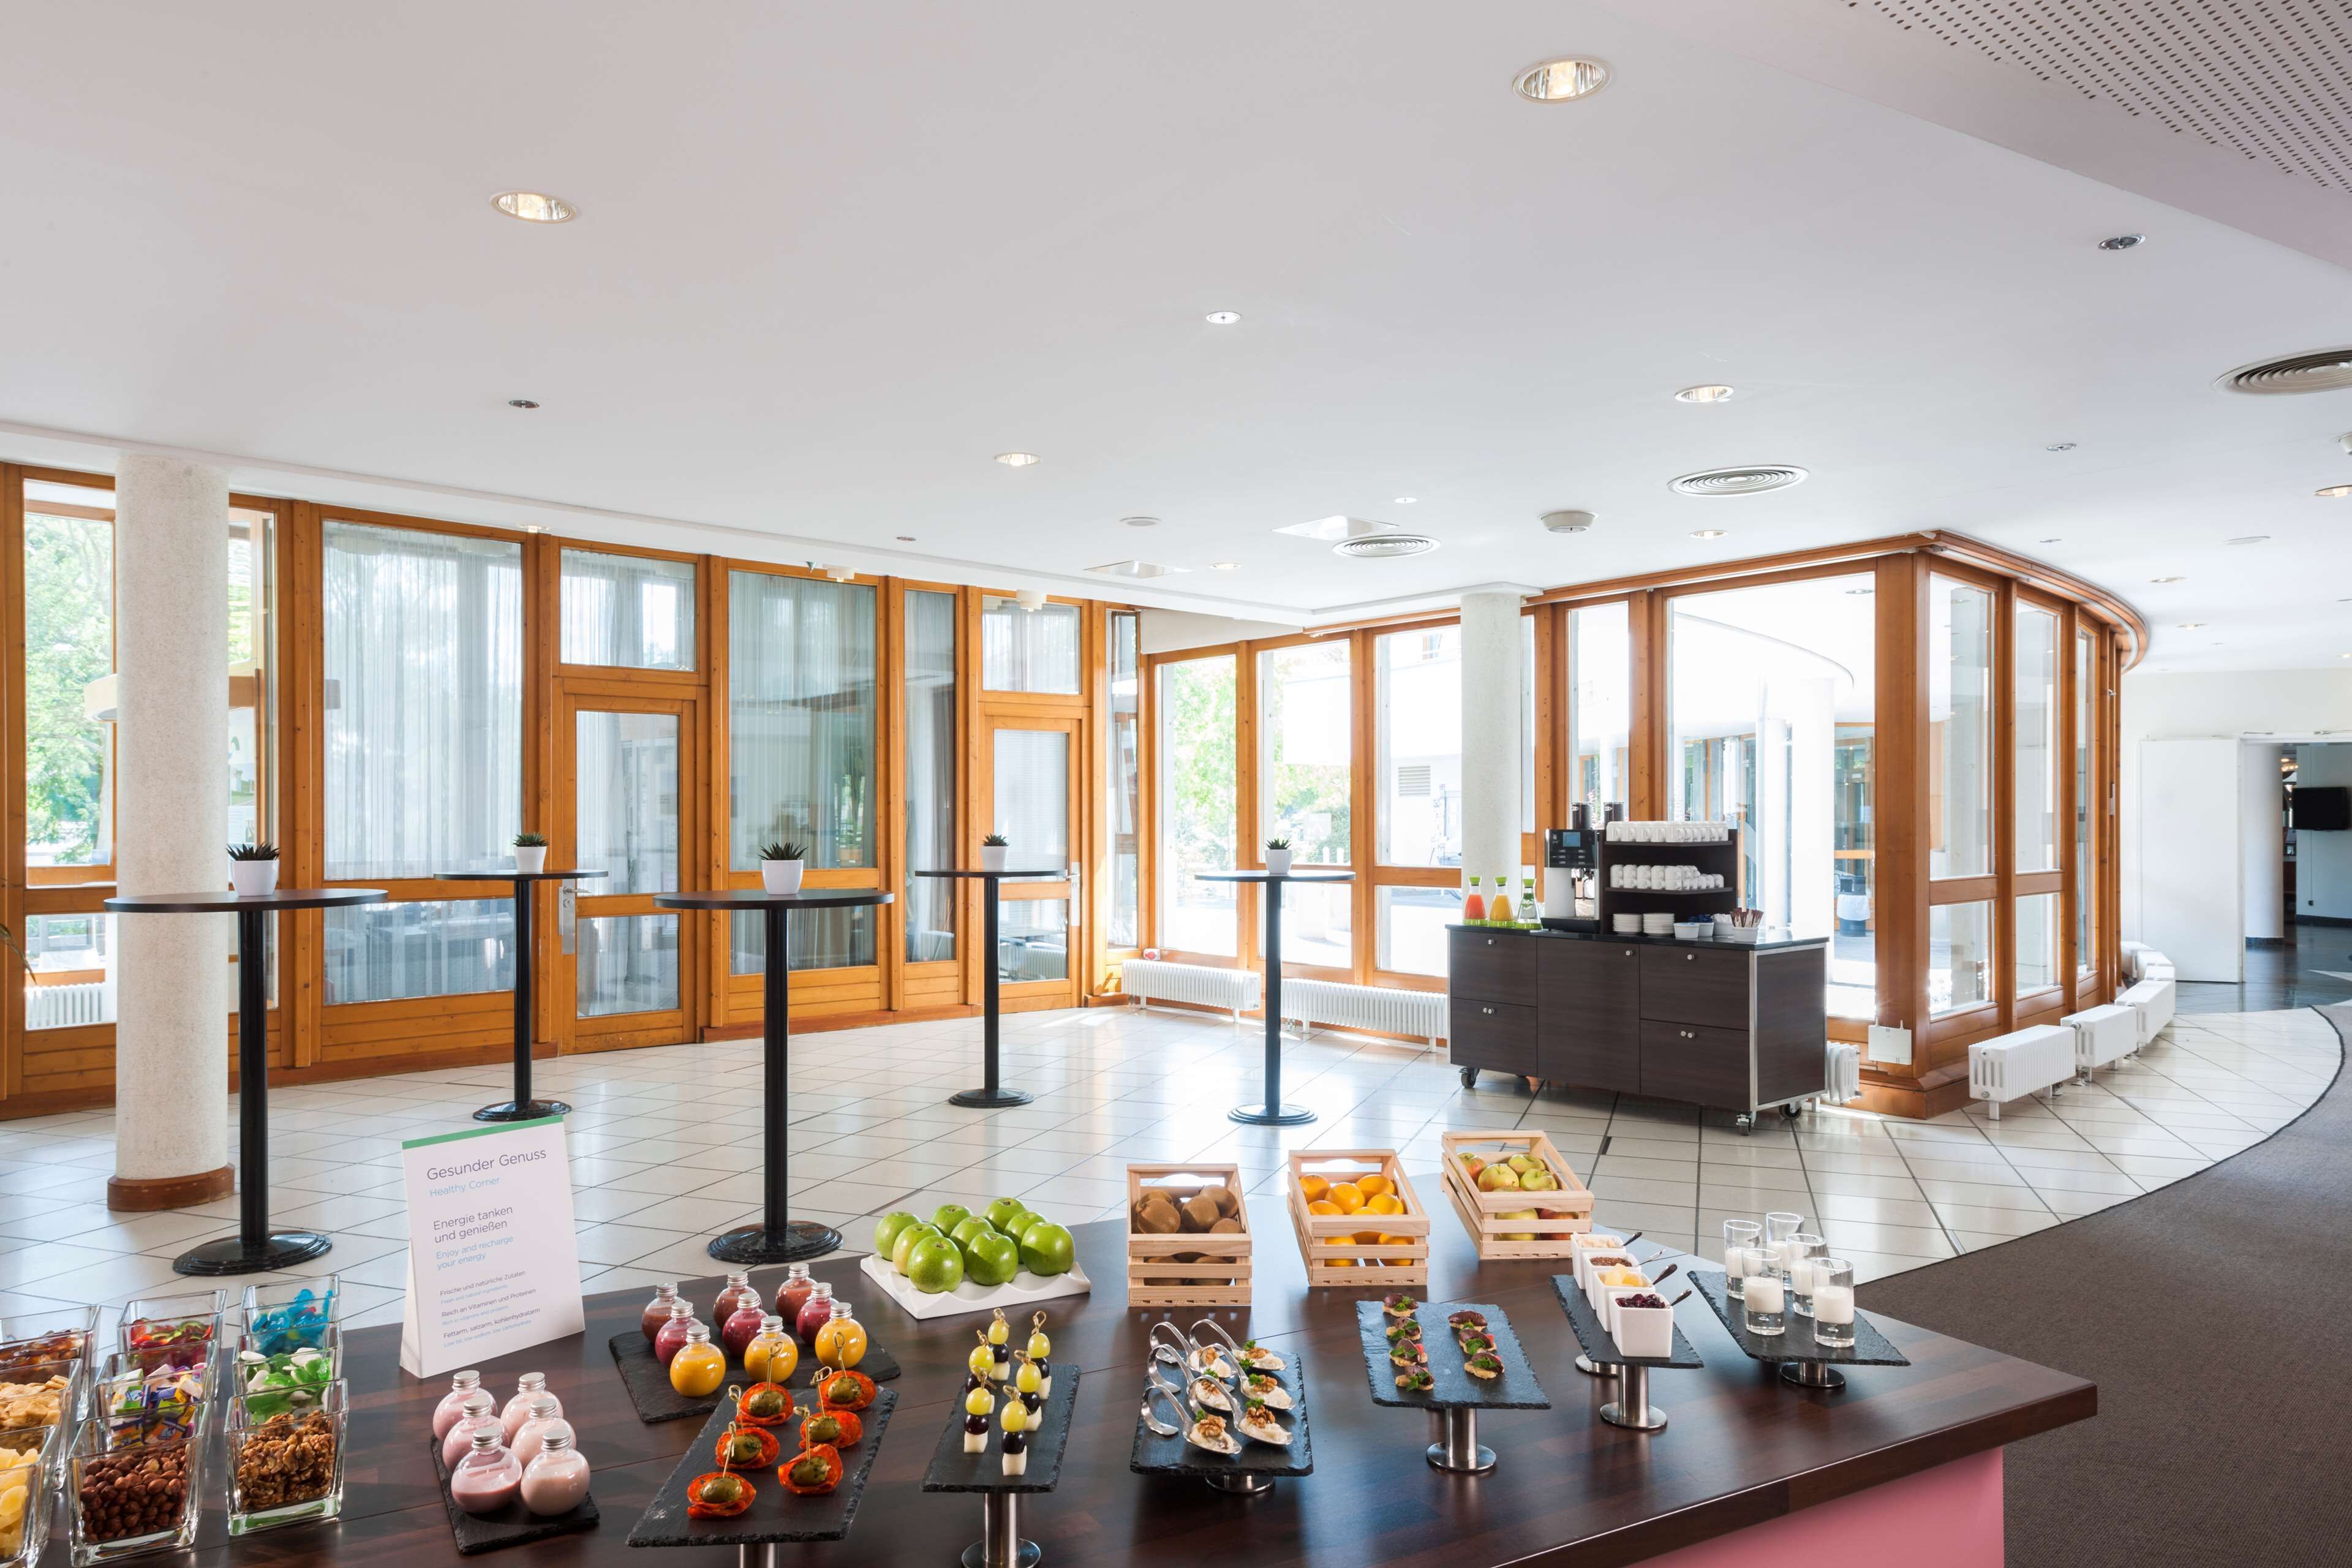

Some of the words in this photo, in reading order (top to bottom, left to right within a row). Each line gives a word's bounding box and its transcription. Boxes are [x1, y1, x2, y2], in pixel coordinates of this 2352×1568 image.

[427, 1159, 494, 1180] Gesunder
[499, 1150, 546, 1166] Genuss
[430, 1184, 466, 1197] Healthy
[469, 1177, 500, 1189] Corner
[434, 1213, 475, 1231] Energie
[478, 1207, 513, 1221] tanken
[435, 1230, 456, 1243] und
[459, 1220, 507, 1240] genießen
[436, 1249, 459, 1259] Enjoy
[461, 1243, 477, 1253] and
[479, 1236, 513, 1249] recharge
[437, 1259, 456, 1271] your
[458, 1253, 486, 1264] energy
[440, 1287, 462, 1296] Frische
[475, 1276, 502, 1287] natürliche
[505, 1270, 526, 1280] Zutaten
[442, 1308, 458, 1317] Reich
[468, 1298, 497, 1311] Vitaminen
[510, 1288, 536, 1299] Proteinen
[443, 1329, 469, 1338] Fettarm,
[470, 1321, 493, 1332] salzarm,
[494, 1308, 540, 1324] kohlenhydratarm
